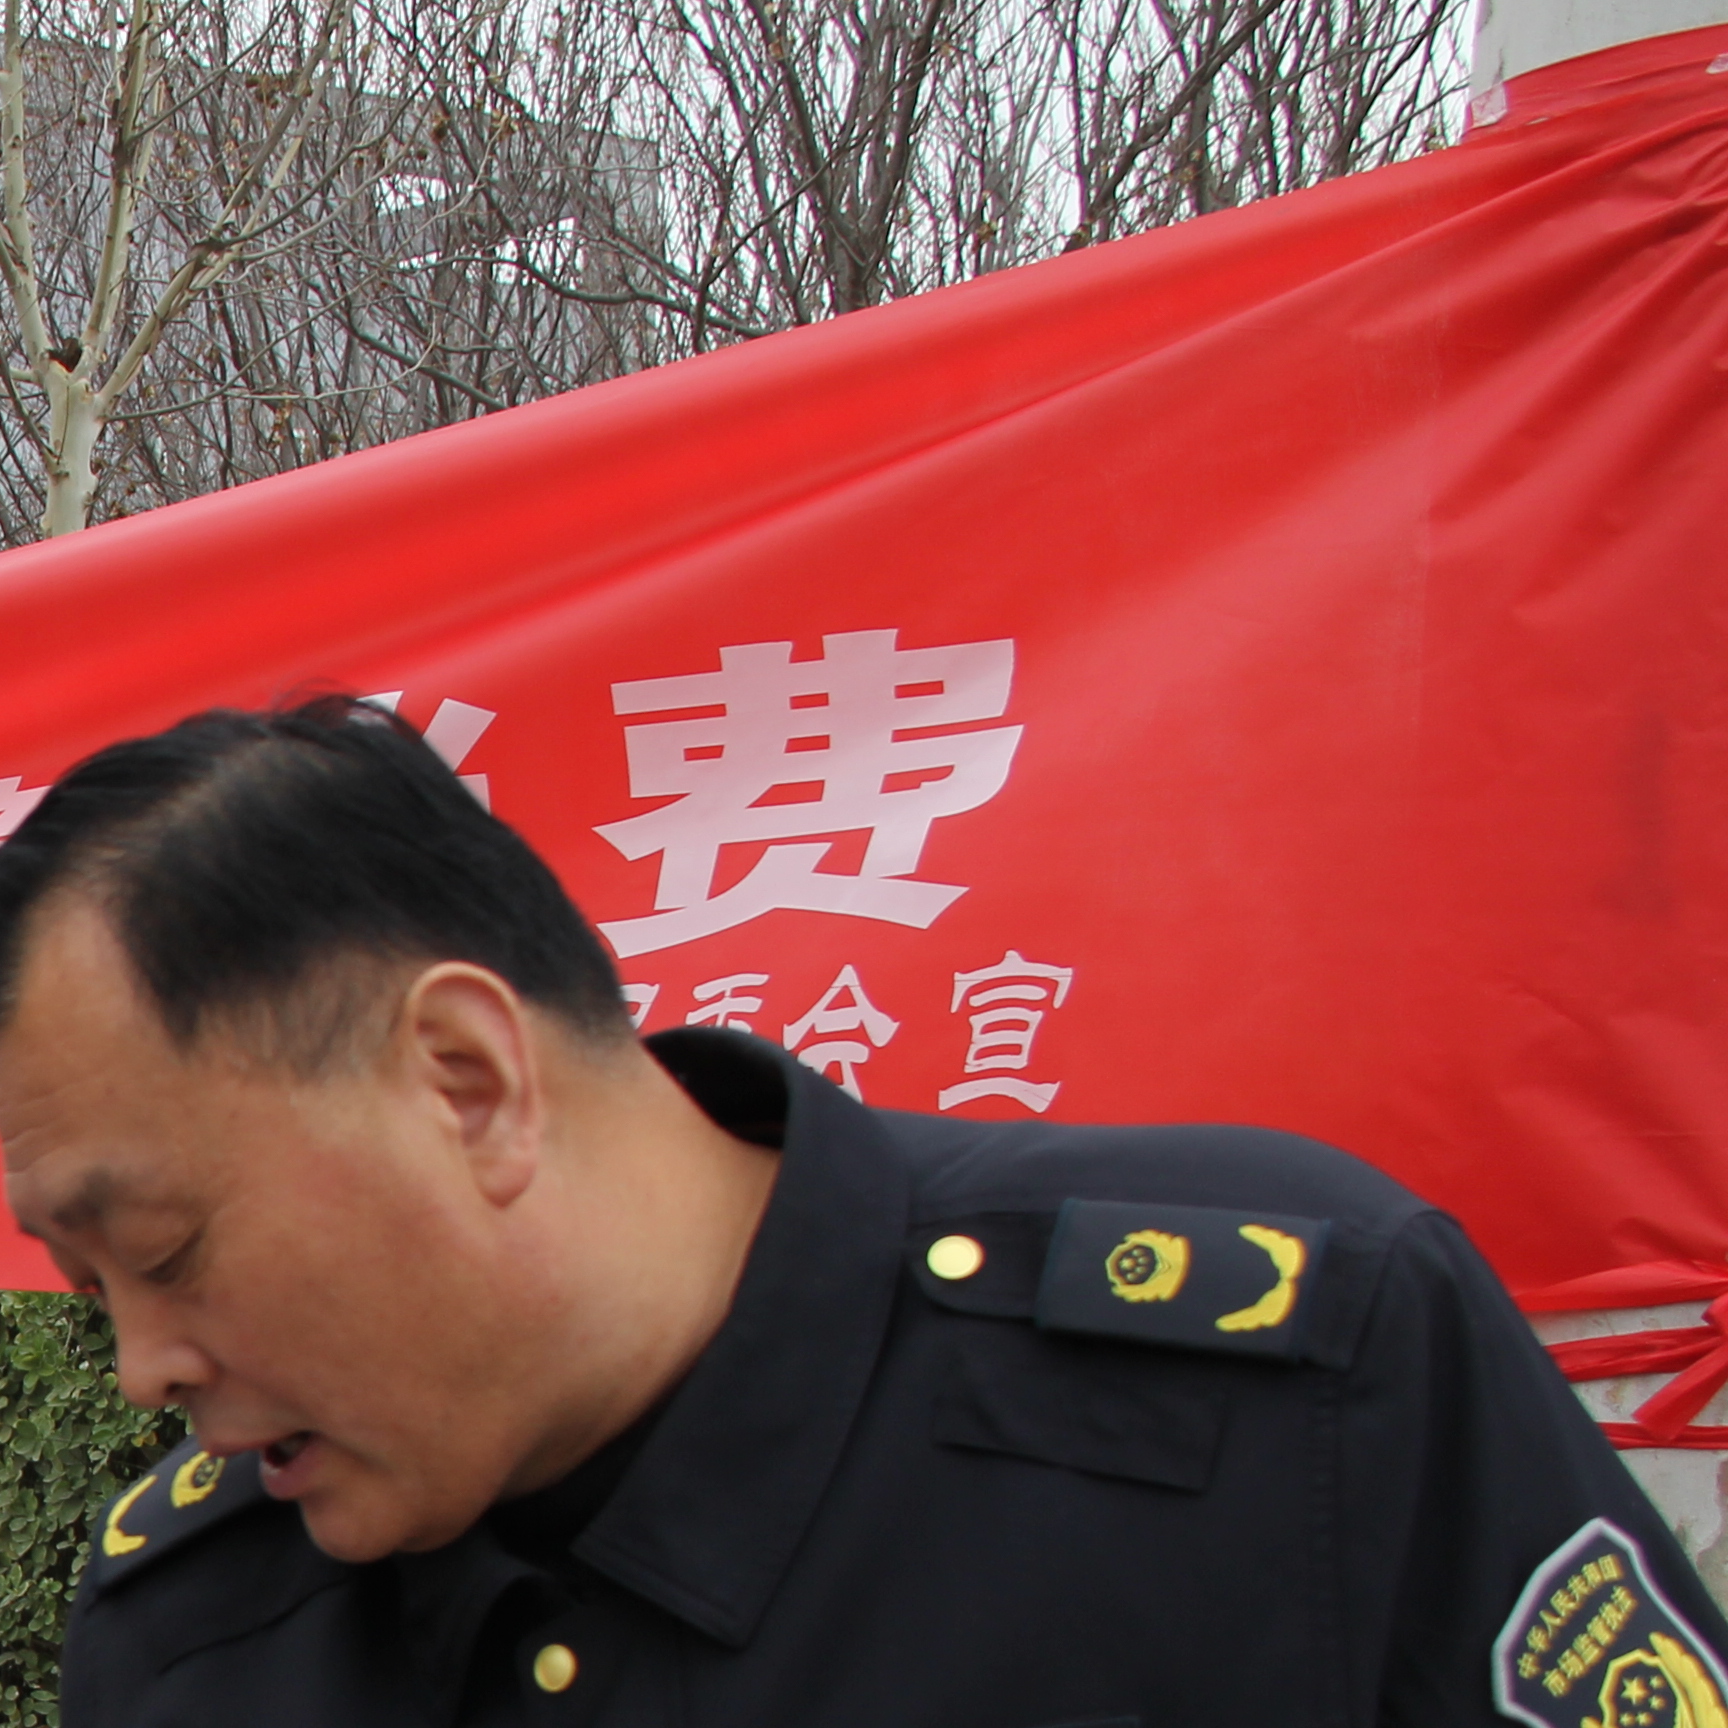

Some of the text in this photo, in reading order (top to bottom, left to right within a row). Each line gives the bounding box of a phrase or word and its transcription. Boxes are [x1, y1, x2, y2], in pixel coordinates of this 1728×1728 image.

[938, 950, 1073, 1113] 宣
[1517, 1553, 1625, 1681] 中华人民共和国
